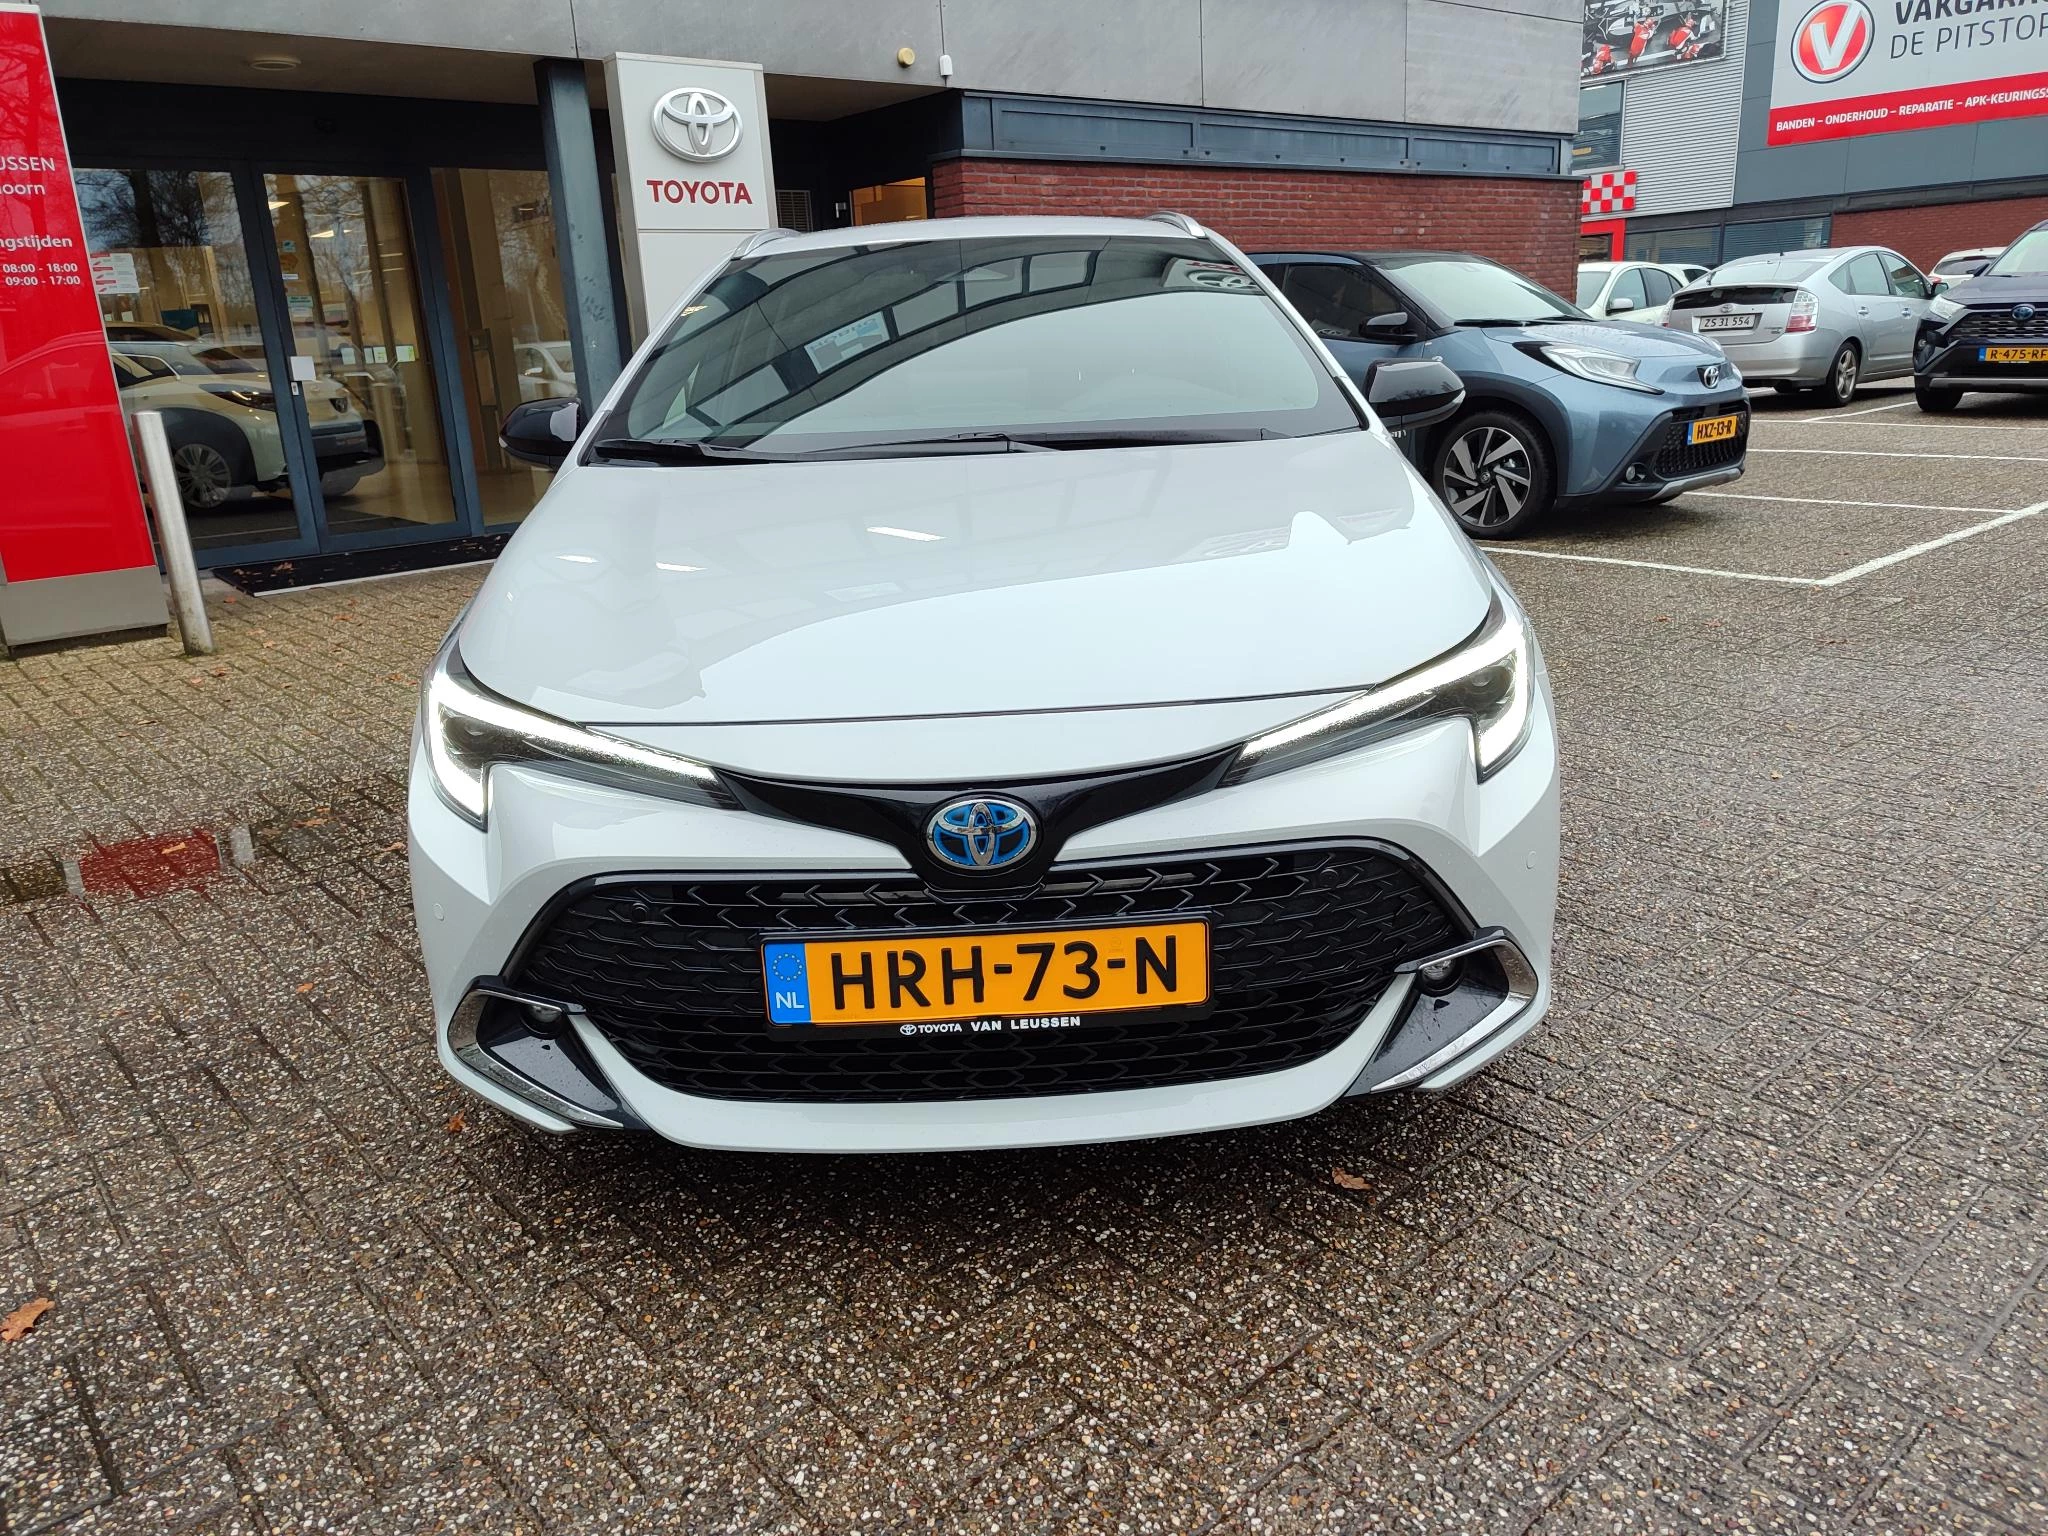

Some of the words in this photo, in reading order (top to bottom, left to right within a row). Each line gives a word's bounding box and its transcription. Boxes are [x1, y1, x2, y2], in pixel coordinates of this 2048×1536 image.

[1895, 0, 2048, 25] VAKGA
[1890, 31, 1925, 59] DE
[1776, 117, 1815, 132] BANDEN
[1825, 107, 1888, 125] ONDERHOUD
[1899, 99, 1954, 116] REPARATIE
[0, 183, 46, 195] oorn
[647, 179, 753, 205] TOYOTA
[2, 263, 36, 273] 08:00
[46, 262, 78, 273] 18:00
[5, 276, 39, 286] 09:00
[49, 275, 81, 286] 17:00
[1704, 318, 1717, 328] ZS
[1719, 317, 1729, 327] 31
[1732, 315, 1751, 326] 554
[775, 991, 805, 1009] NL
[830, 934, 1177, 1010] HRH-73-N
[918, 1023, 963, 1034] TOYOTA
[970, 1020, 1002, 1032] VAN
[1010, 1016, 1081, 1030] LEUSSEN
